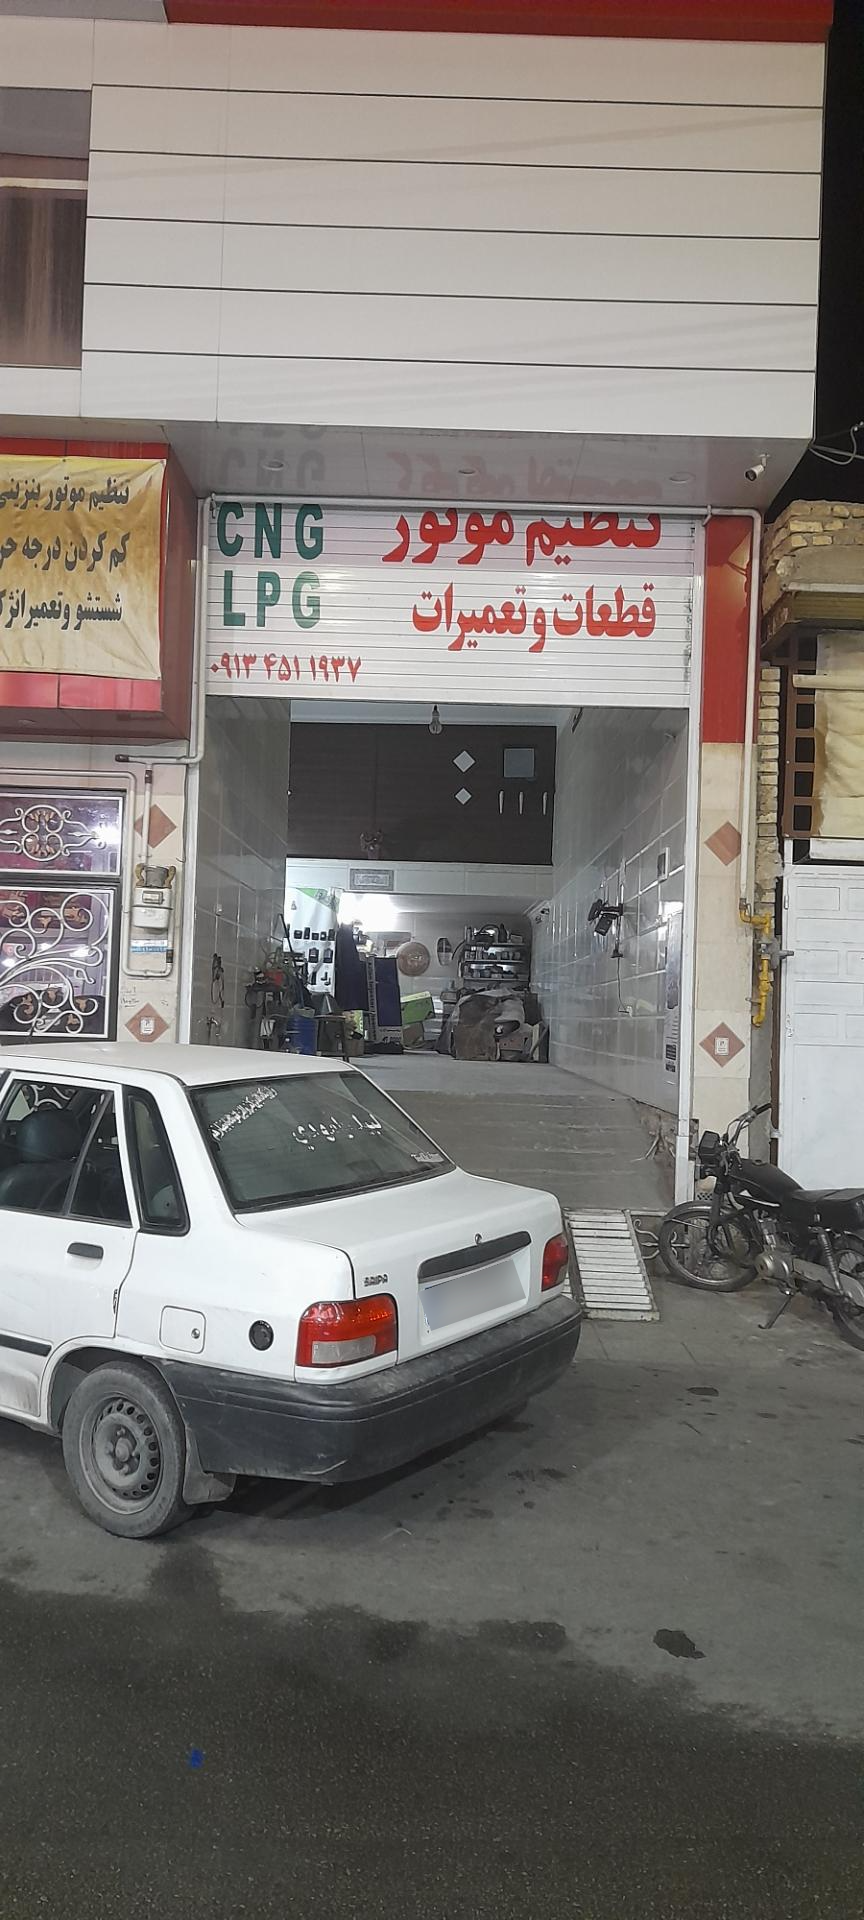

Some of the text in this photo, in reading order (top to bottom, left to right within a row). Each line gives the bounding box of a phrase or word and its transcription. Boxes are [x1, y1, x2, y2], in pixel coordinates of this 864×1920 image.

[43, 475, 86, 511] موتور
[88, 476, 130, 512] تنظیم
[64, 530, 108, 572] کردن
[217, 501, 324, 560] CNG
[21, 535, 61, 571] درجه
[109, 530, 131, 573] کم
[73, 591, 123, 631] شستشو
[223, 570, 321, 629] LPG
[552, 582, 657, 638] قطعات
[363, 1273, 389, 1288] SAIPA
